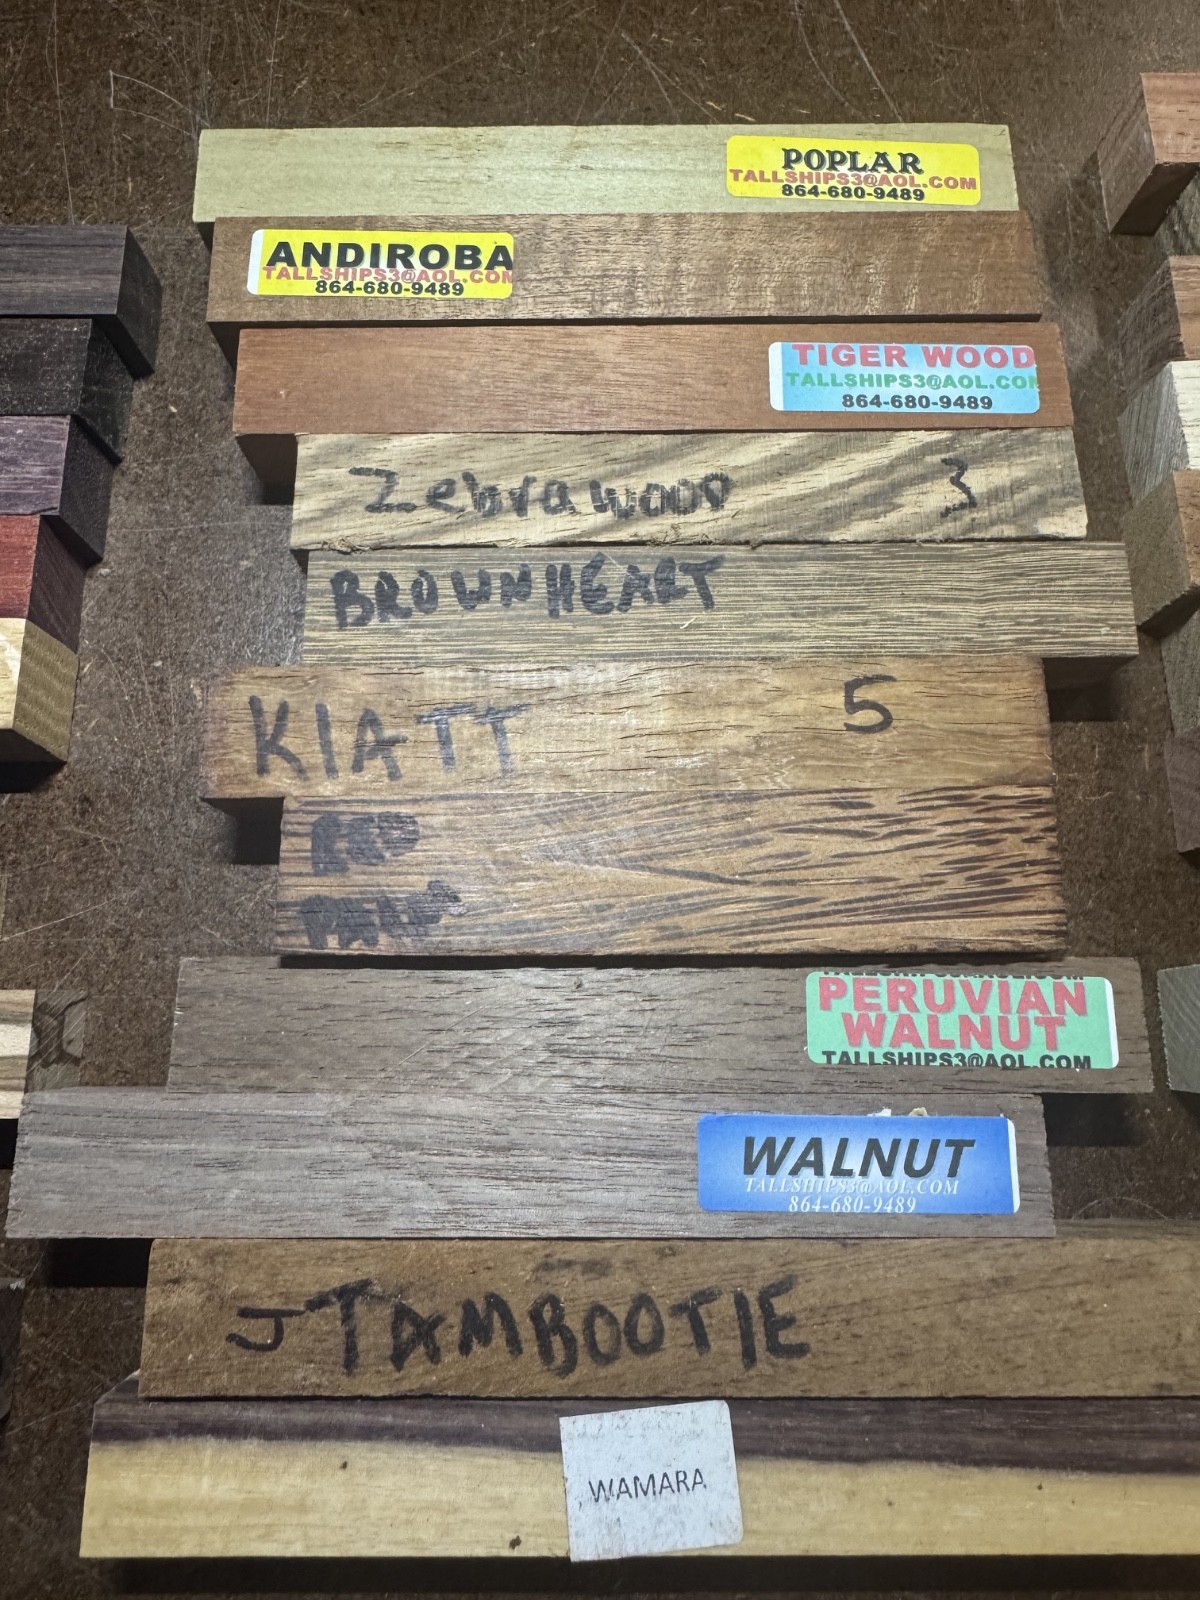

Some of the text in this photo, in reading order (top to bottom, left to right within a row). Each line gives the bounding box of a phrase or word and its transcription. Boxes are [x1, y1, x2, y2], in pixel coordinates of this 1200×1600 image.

[781, 148, 924, 175] POPLAR
[729, 168, 977, 190] TALLSHIPS3@AOL.COM
[781, 184, 925, 201] 864-680-9489
[265, 241, 513, 270] ANDIROBA
[315, 280, 464, 296] 864-680-9489
[792, 343, 1036, 369] TIGER WOOD
[841, 393, 993, 410] 864-680-9489
[248, 674, 898, 781] KIATT 5
[818, 976, 1087, 1016] PERUVIAN
[841, 1012, 1065, 1050] WALNUT
[743, 1136, 976, 1177] WALNUT
[744, 1176, 960, 1196] TALLSHIPS3@AOL.COM
[788, 1195, 917, 1213] 864-680-9489
[588, 1467, 708, 1503] WAMARA
